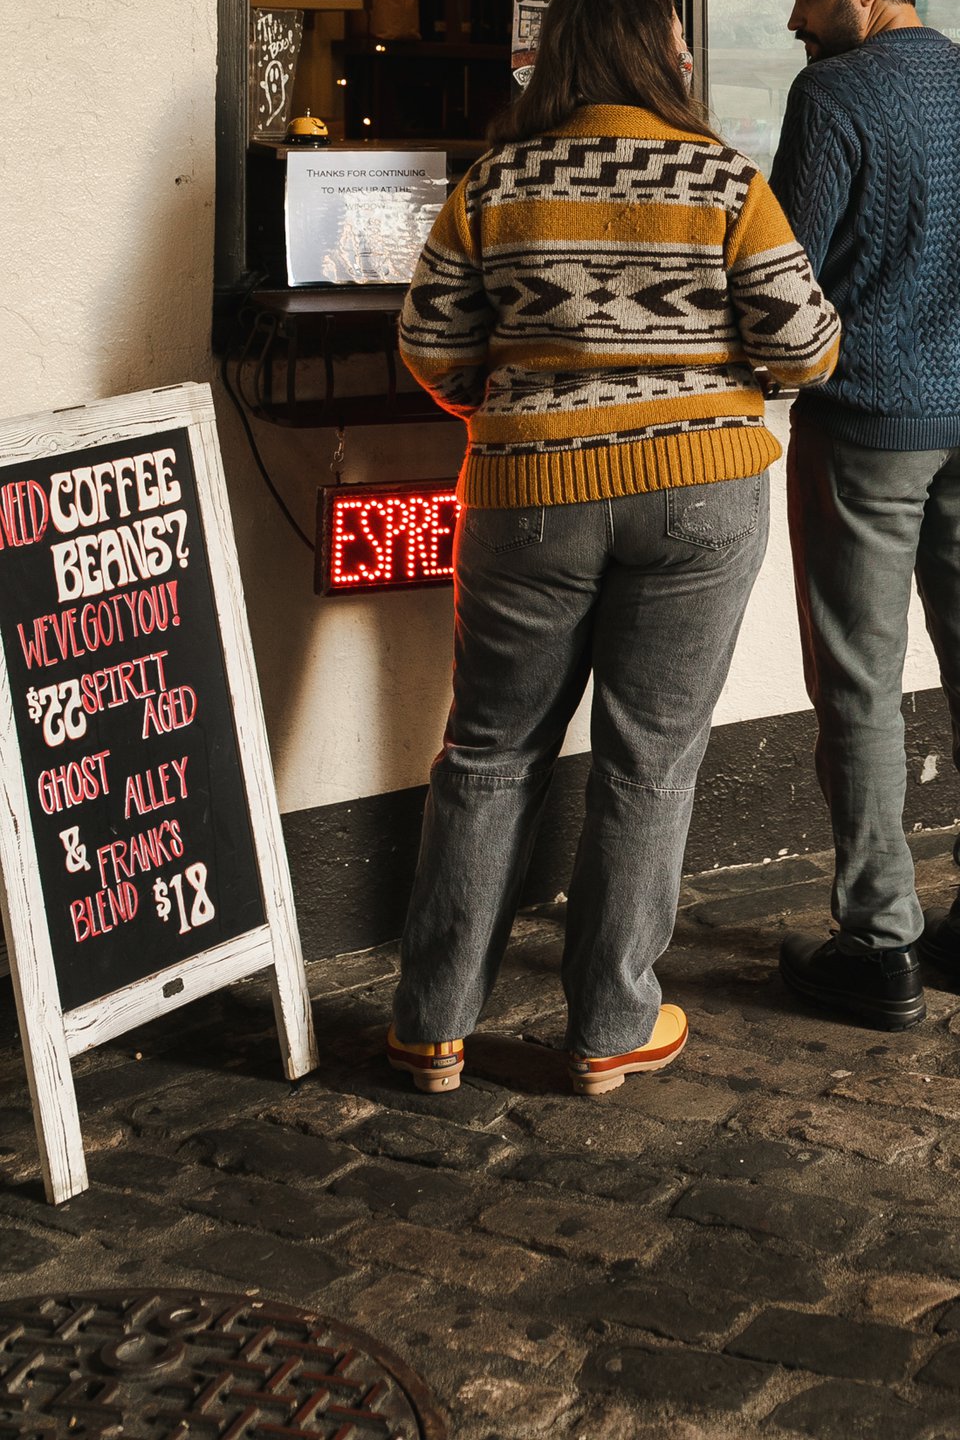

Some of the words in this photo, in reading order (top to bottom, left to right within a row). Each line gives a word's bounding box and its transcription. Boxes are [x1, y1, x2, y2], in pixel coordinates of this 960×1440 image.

[306, 169, 345, 178] THANKS
[347, 169, 367, 178] FOR
[368, 169, 426, 178] CONTINUING
[321, 186, 335, 194] TO
[338, 186, 363, 194] MASK
[0, 479, 49, 549] NEED
[49, 448, 182, 533] COFFEE
[334, 495, 462, 583] ESPRE
[50, 509, 190, 604] BEANS?
[17, 607, 86, 670] WE'VE
[80, 593, 124, 652] GOT
[123, 580, 181, 638] YOU!
[26, 678, 88, 748] $22
[80, 650, 169, 715] SPIRIT
[142, 685, 198, 740] AGED
[38, 749, 111, 815] GHOST
[124, 755, 189, 820] ALLEY
[59, 824, 92, 874] &
[96, 819, 184, 889] FRANK'S
[70, 881, 139, 943] BLEND
[152, 861, 216, 936] $18
